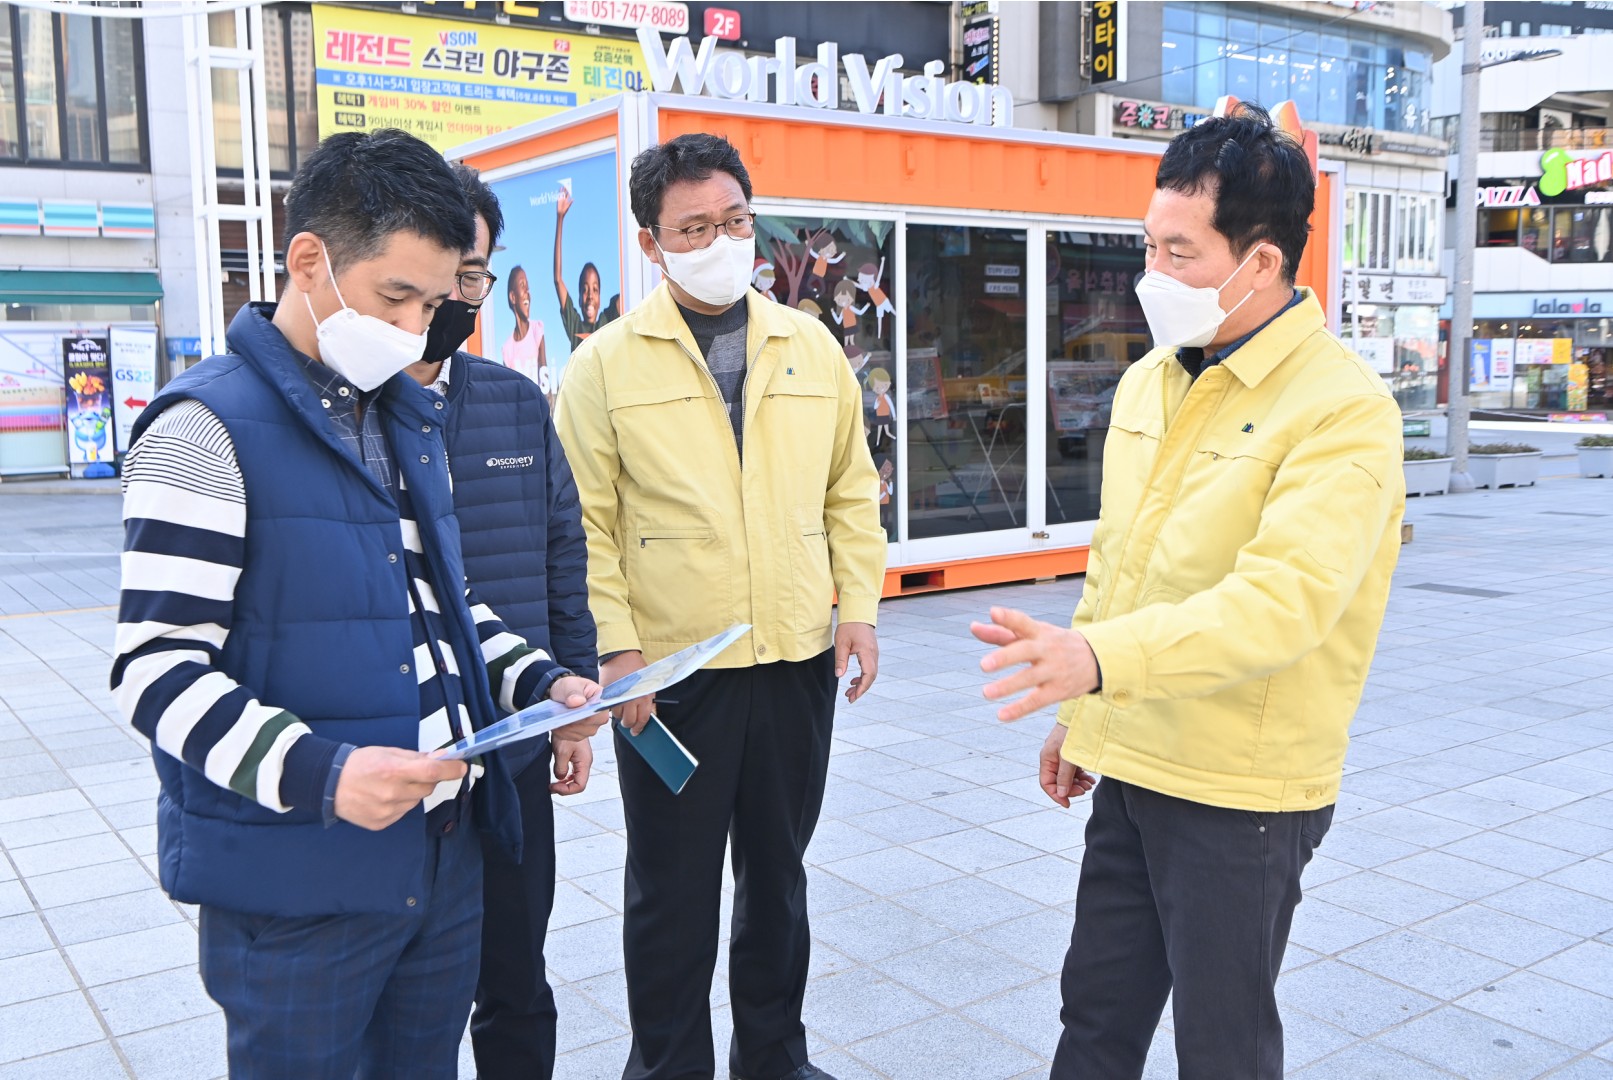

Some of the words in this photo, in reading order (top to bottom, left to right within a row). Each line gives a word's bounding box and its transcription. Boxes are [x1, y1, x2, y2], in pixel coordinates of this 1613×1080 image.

[591, 1, 686, 27] 051-747-8089
[712, 13, 735, 36] 2F
[326, 30, 411, 67] 레전드
[422, 47, 484, 74] 스크린
[493, 48, 570, 83] 야구존
[636, 26, 838, 108] World
[842, 52, 1014, 128] Vision
[404, 98, 428, 111] 30%
[115, 368, 152, 382] GS25
